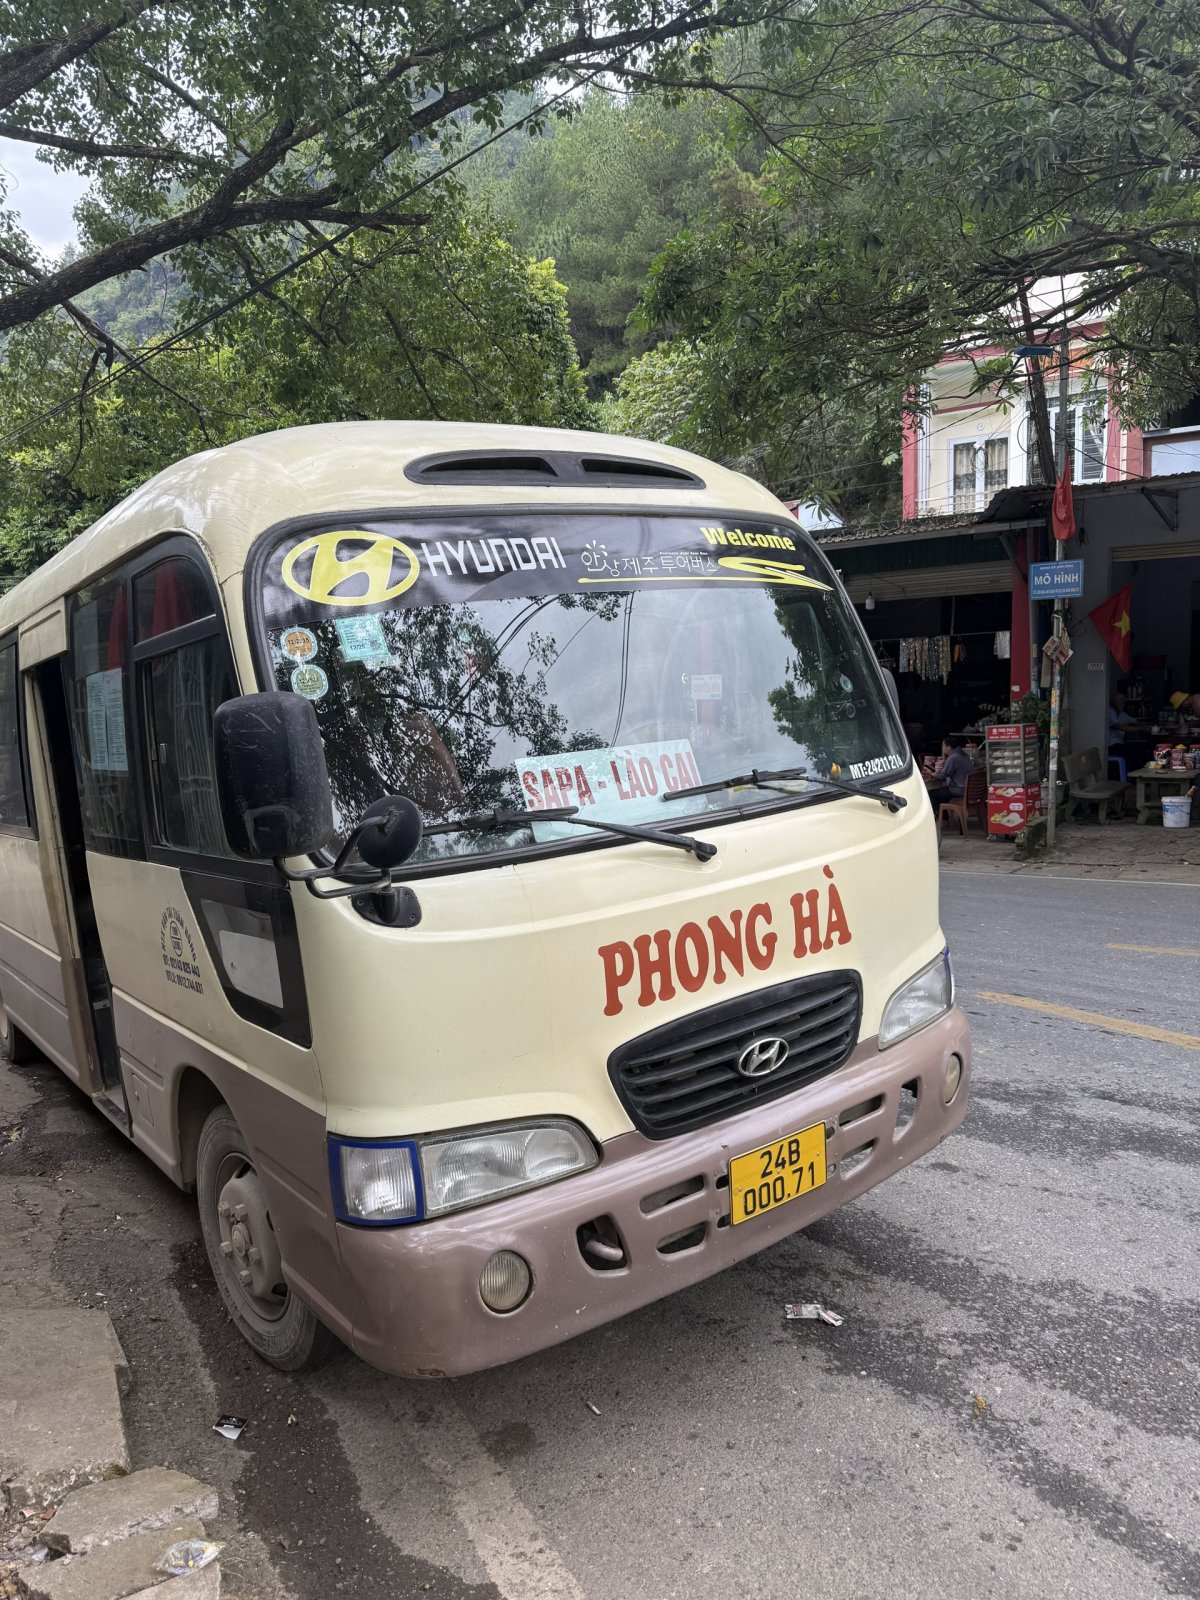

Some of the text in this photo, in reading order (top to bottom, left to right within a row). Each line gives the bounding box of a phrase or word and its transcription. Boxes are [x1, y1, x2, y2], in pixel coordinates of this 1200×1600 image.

[420, 537, 567, 577] HYUNDAI
[700, 526, 797, 552] Welcome
[1034, 571, 1079, 586] MÔ HÌNH
[521, 764, 596, 811] SAPA
[610, 749, 659, 801] LÀO
[659, 751, 703, 793] CAI
[597, 864, 852, 1016] PHONG HÀ
[759, 1137, 801, 1179] 24B
[743, 1163, 817, 1216] 000.71
